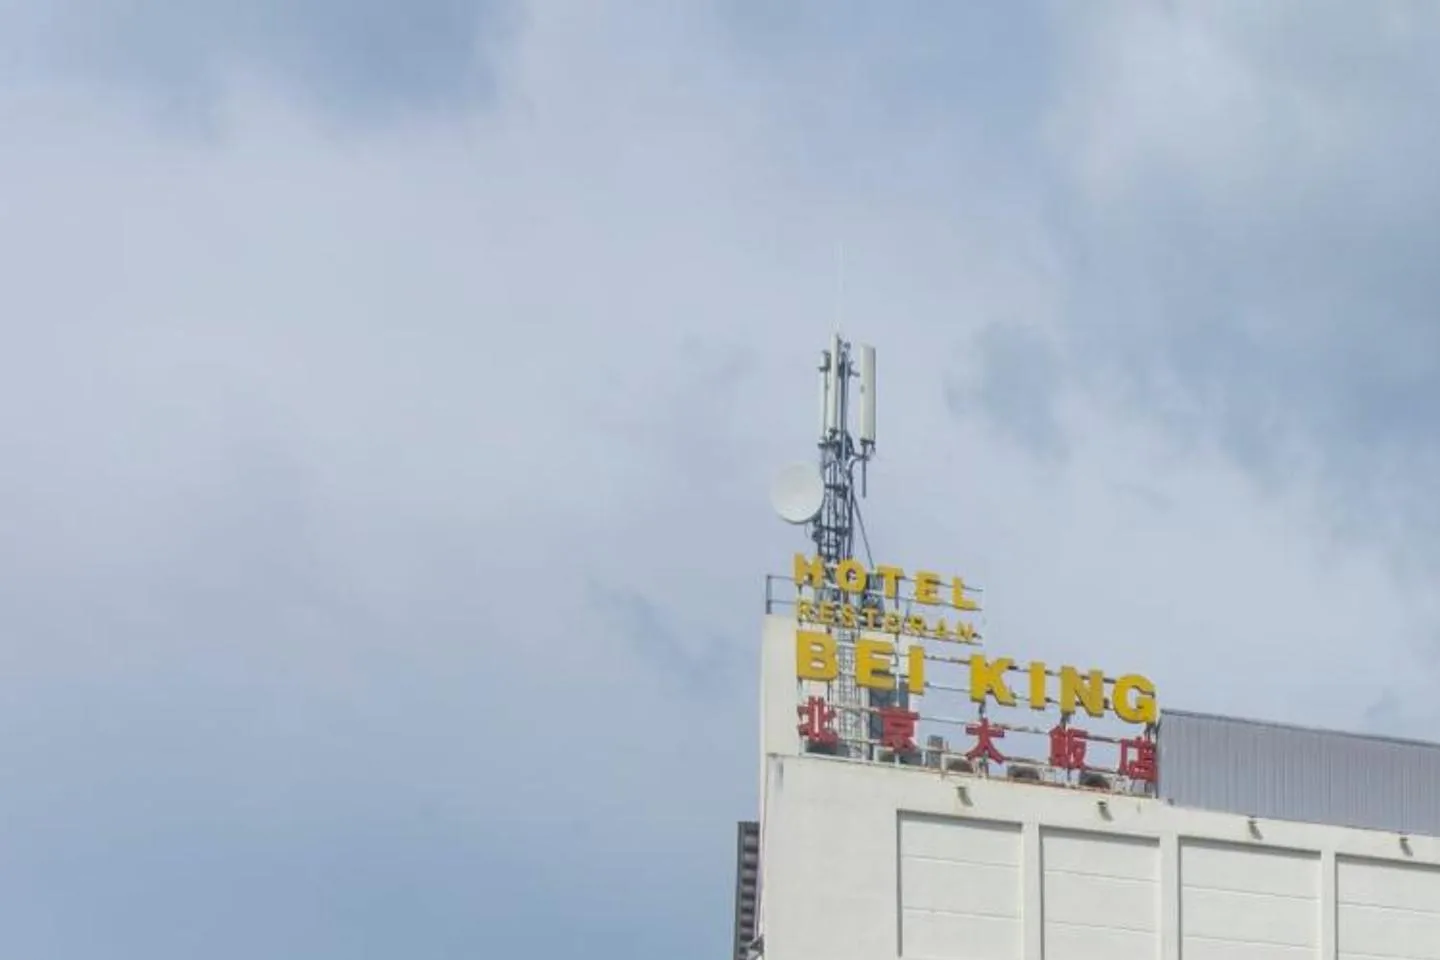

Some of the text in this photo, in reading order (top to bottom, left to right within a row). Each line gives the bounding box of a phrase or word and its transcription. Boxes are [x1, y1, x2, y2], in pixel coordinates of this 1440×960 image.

[793, 552, 977, 612] HOTEL
[796, 630, 1158, 724] BEI KING
